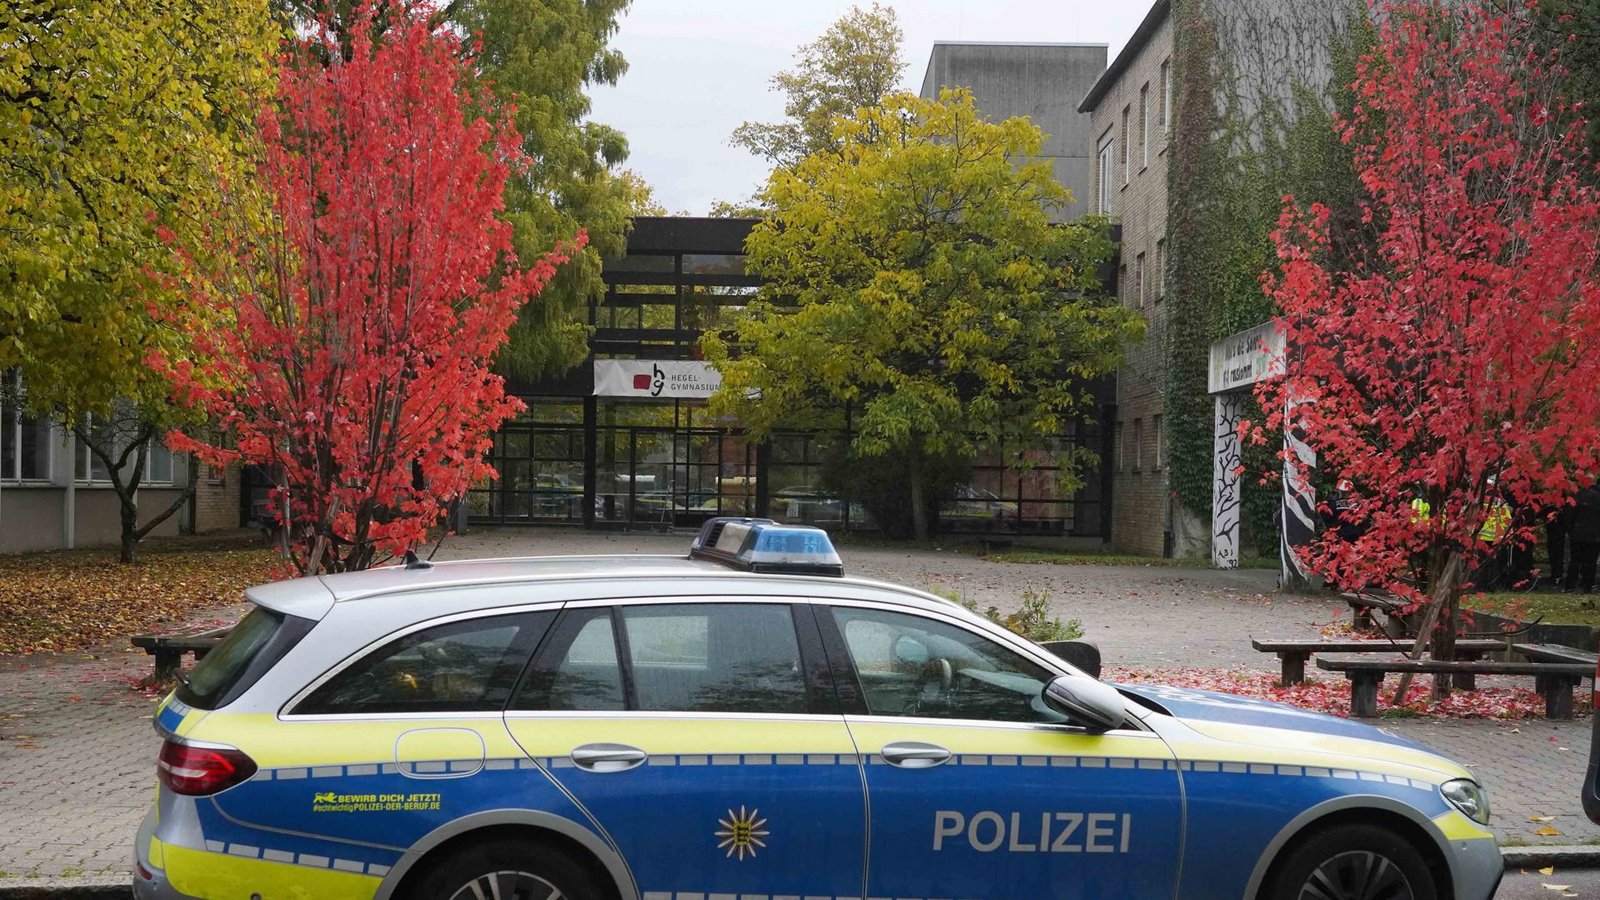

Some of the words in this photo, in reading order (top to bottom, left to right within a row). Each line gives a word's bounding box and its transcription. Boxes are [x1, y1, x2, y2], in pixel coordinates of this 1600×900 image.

[671, 374, 702, 382] HEGEL-
[379, 794, 404, 802] DICH
[407, 793, 440, 802] JETZT!
[933, 810, 1131, 852] POLIZEI
